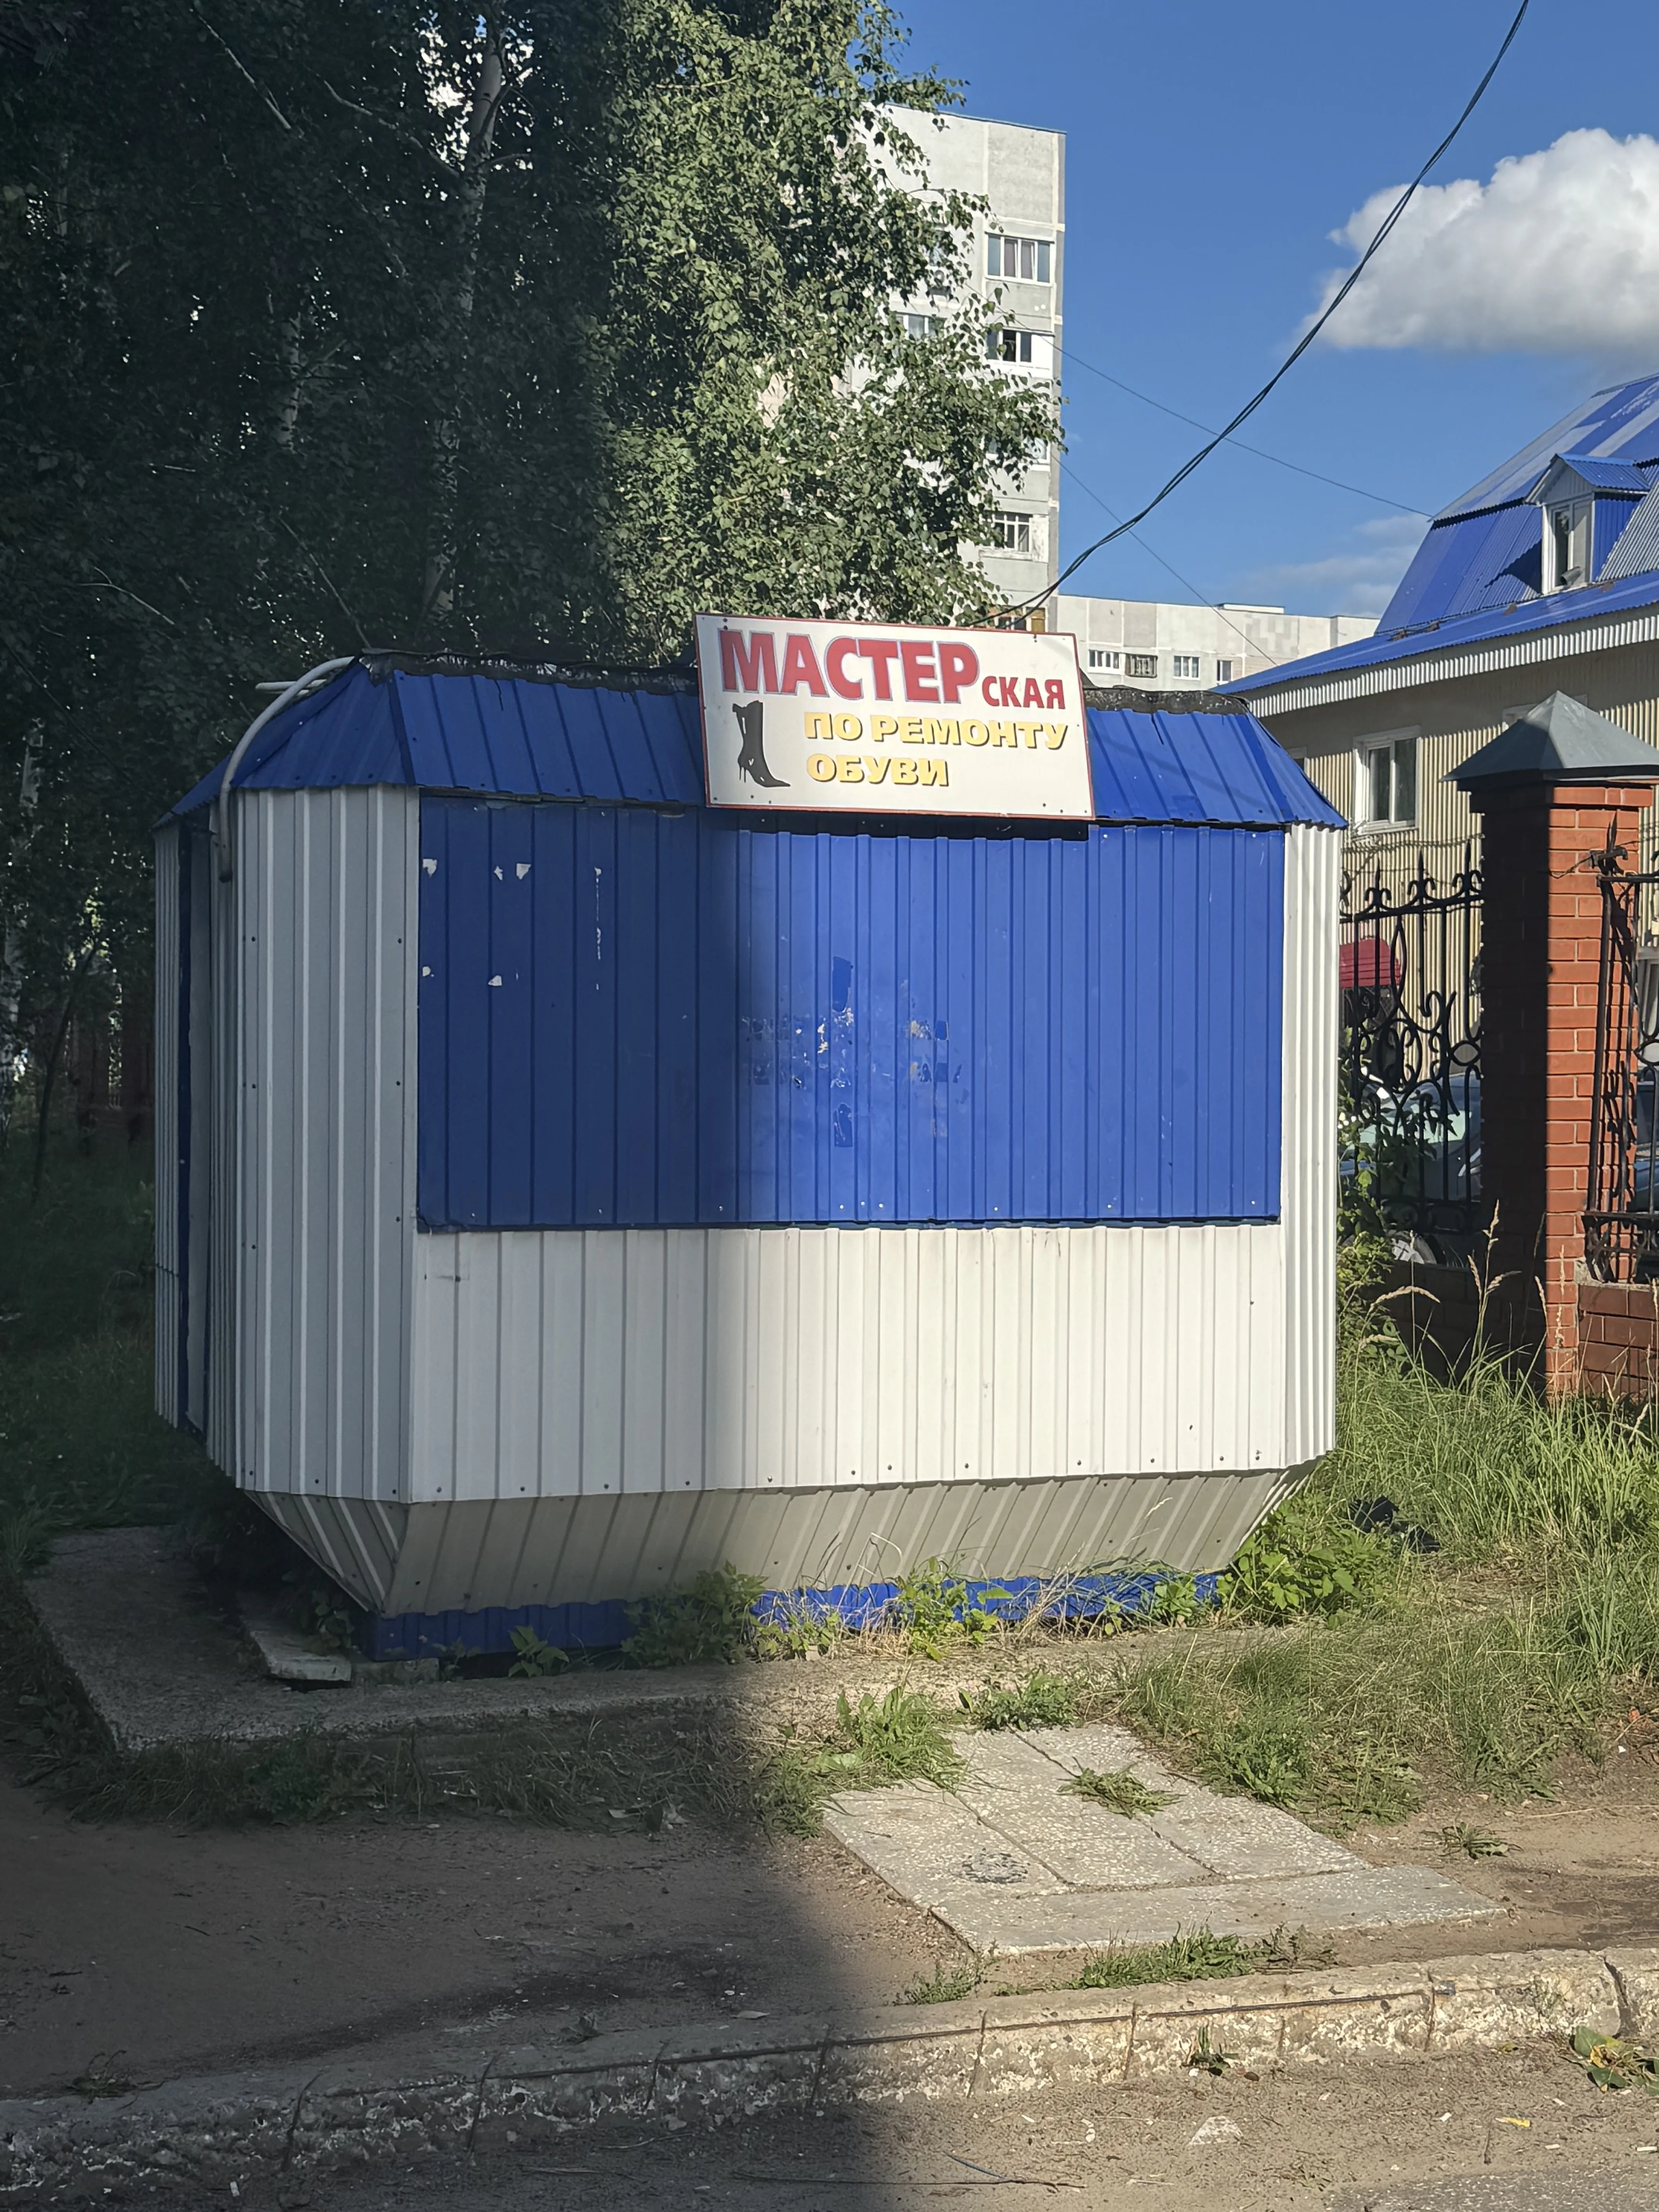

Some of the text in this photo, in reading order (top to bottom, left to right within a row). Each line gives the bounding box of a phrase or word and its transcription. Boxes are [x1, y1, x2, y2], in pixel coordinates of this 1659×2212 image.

[804, 712, 1068, 750] ПО РЕМОНТУ
[806, 754, 949, 787] ОБУВИ
